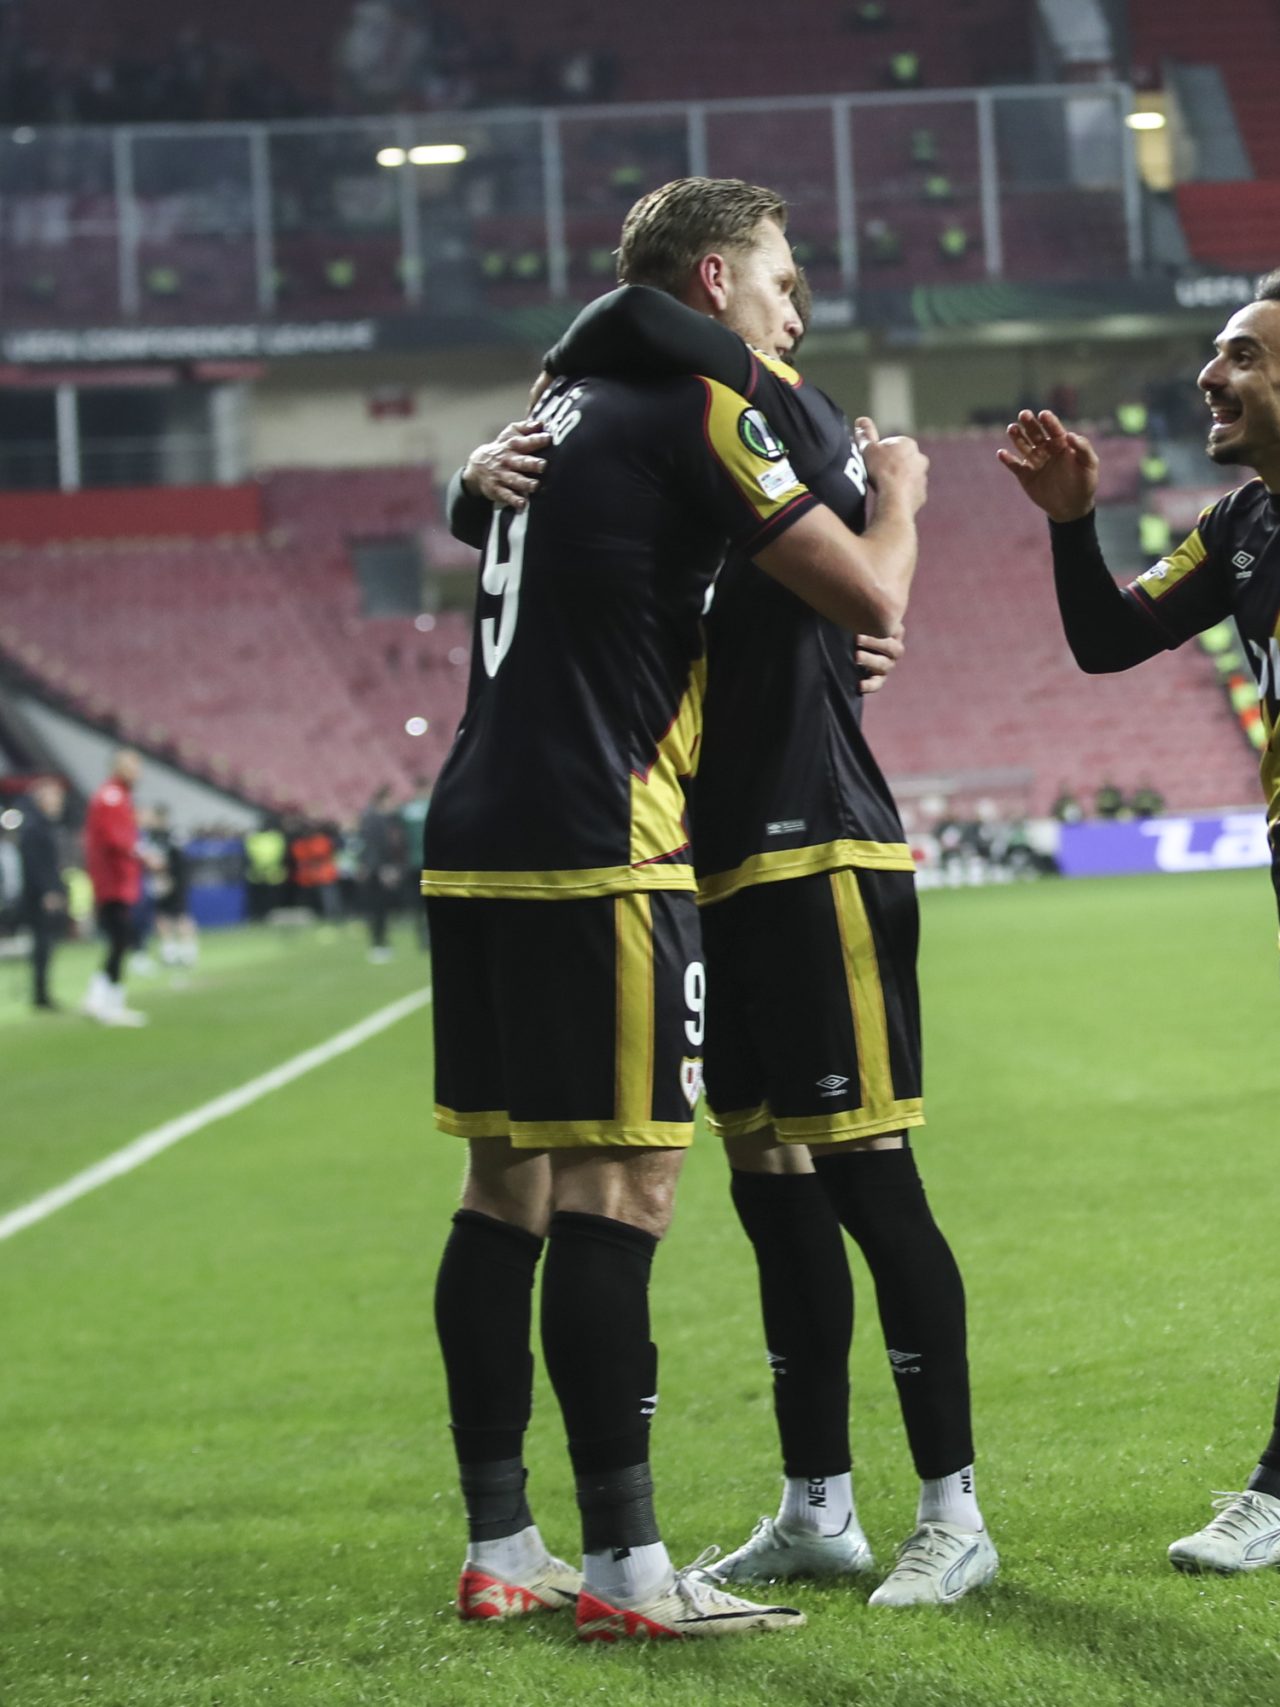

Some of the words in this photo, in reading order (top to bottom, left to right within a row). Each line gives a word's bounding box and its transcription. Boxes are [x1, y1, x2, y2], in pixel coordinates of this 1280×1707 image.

[1175, 276, 1249, 307] UEFA
[481, 497, 530, 679] 9
[683, 961, 706, 1046] 9
